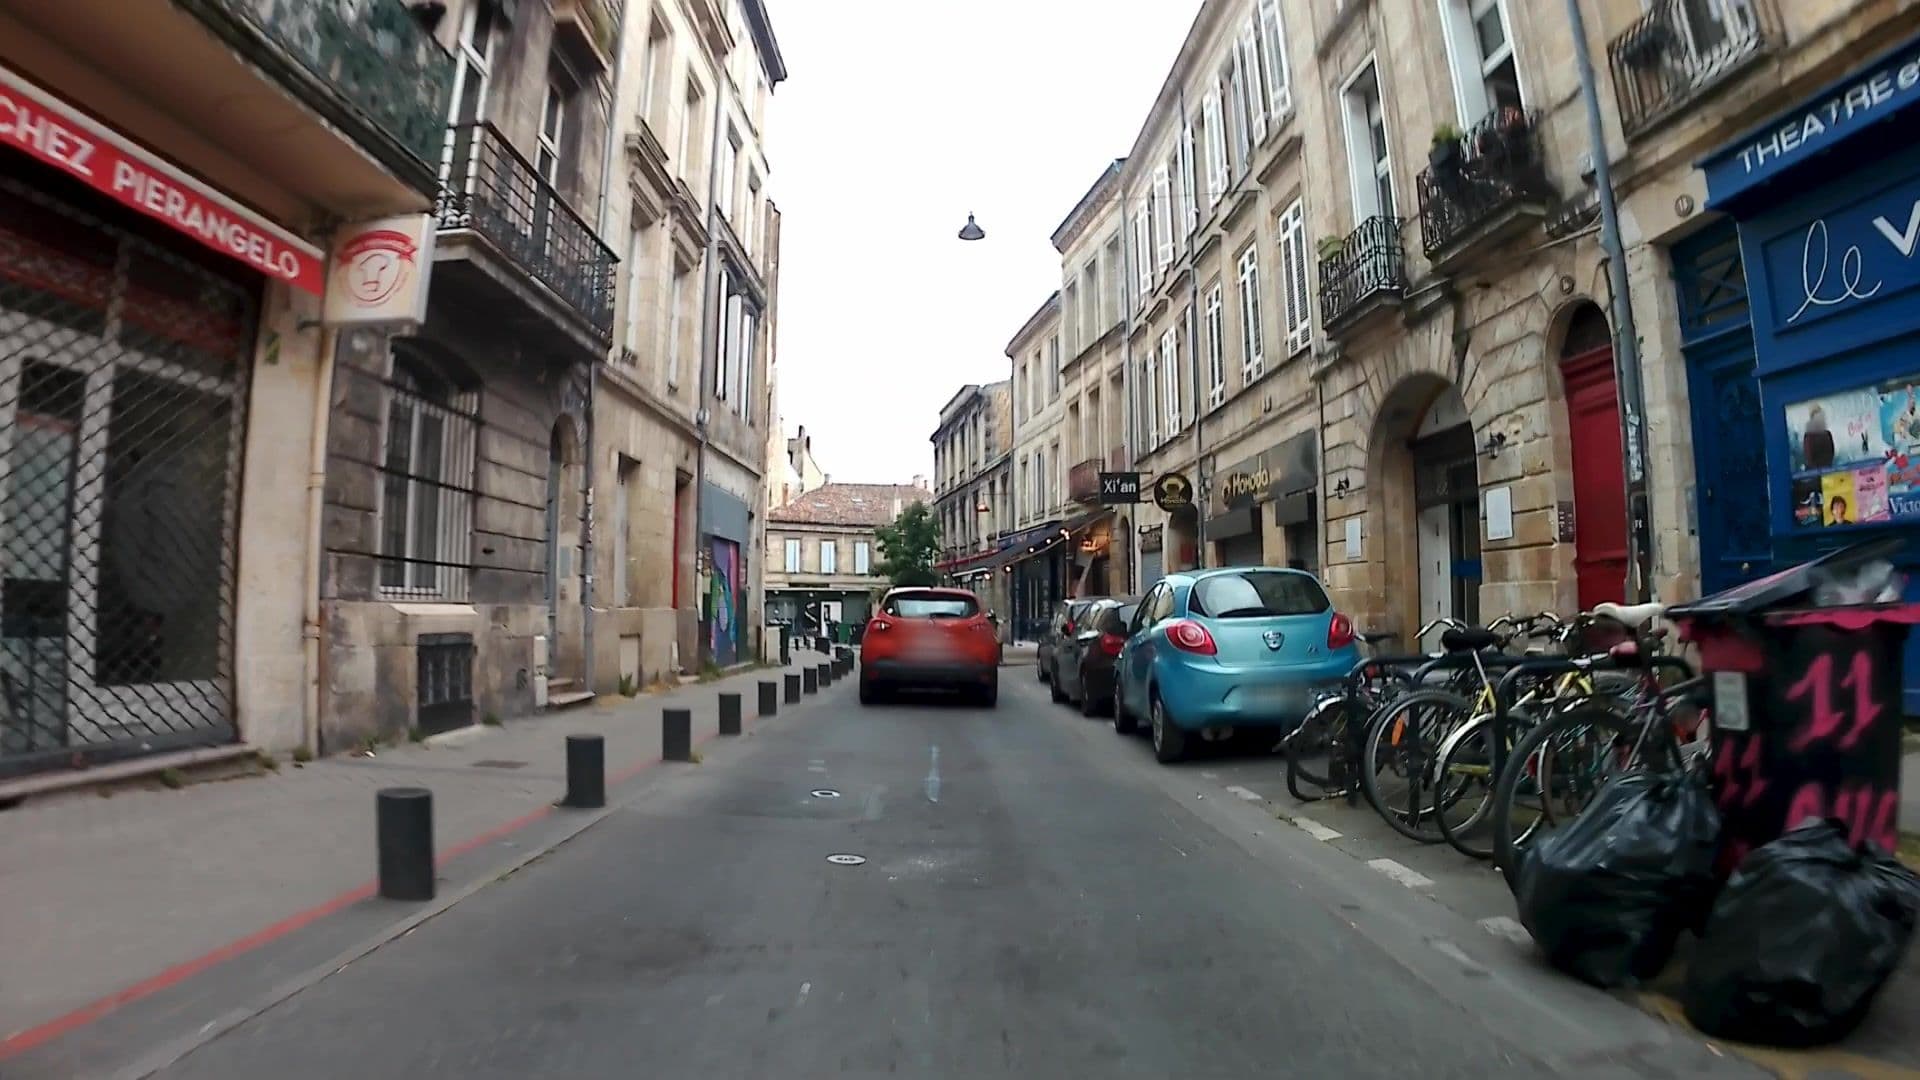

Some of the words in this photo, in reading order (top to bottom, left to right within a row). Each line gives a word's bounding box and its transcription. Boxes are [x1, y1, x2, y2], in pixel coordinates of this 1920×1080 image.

[1736, 70, 1895, 175] THEATRE
[112, 159, 301, 280] PIERANGELO
[1786, 218, 1883, 323] le
[1103, 478, 1137, 494] Xi'an
